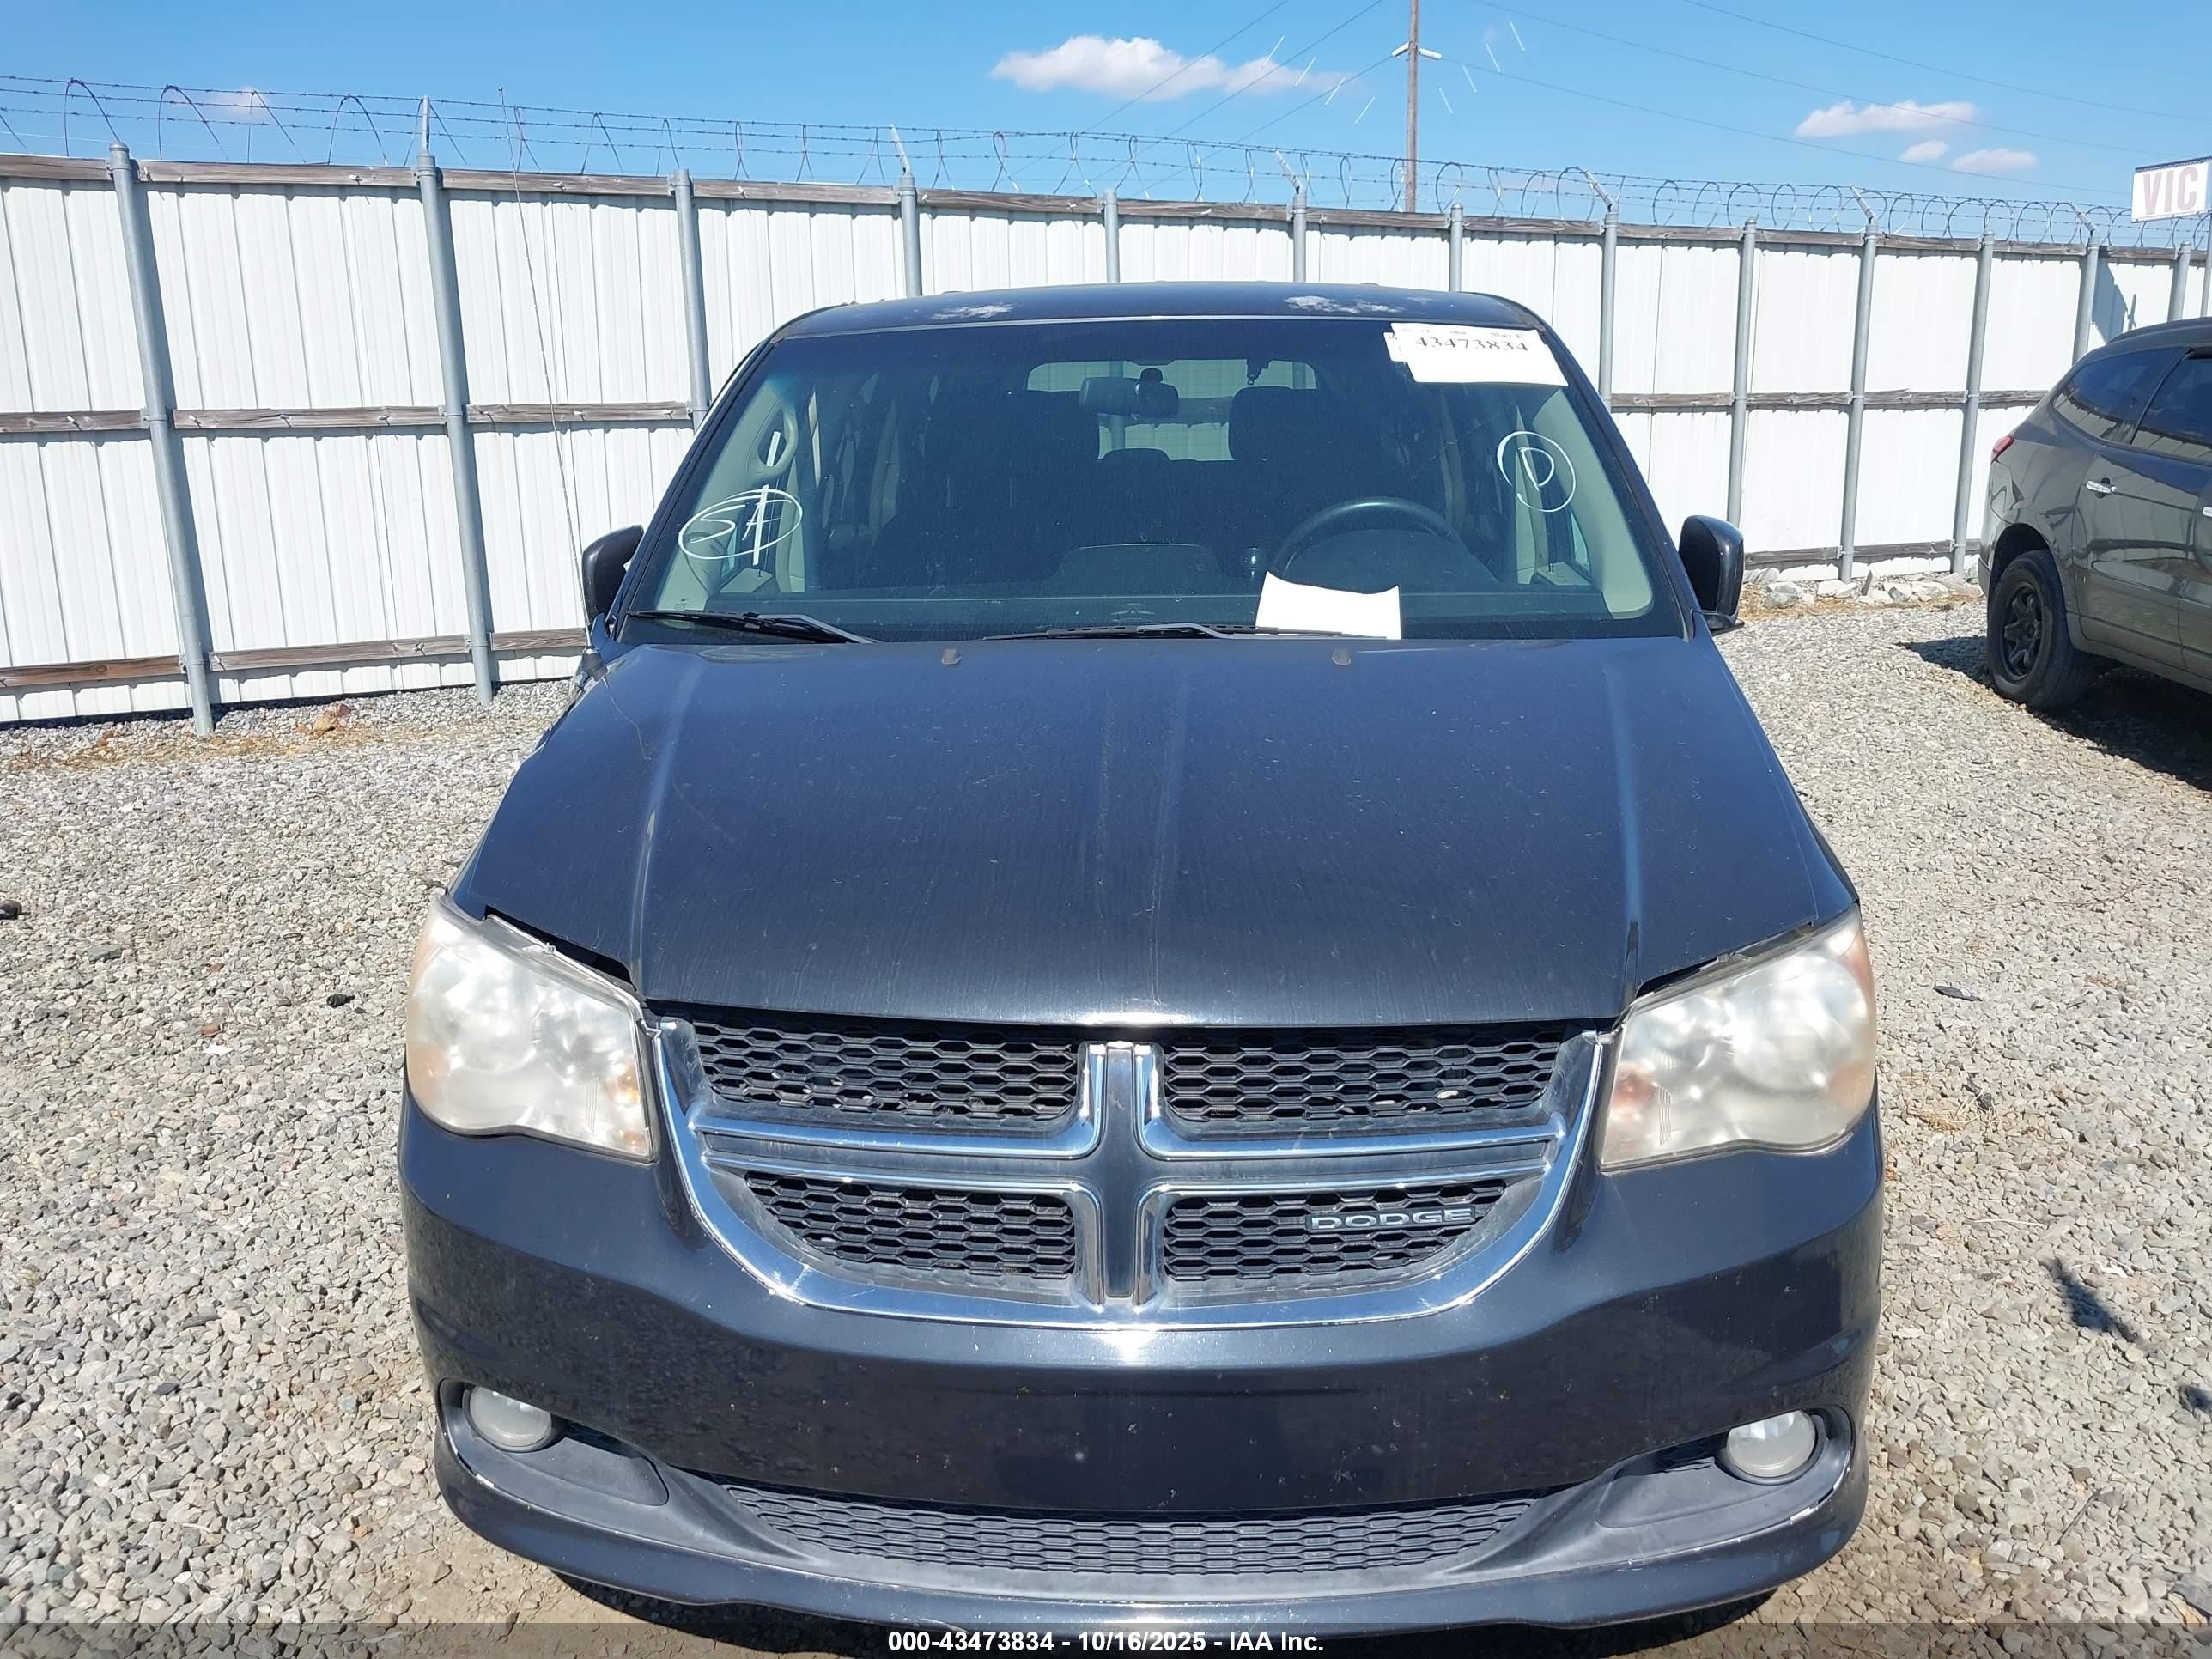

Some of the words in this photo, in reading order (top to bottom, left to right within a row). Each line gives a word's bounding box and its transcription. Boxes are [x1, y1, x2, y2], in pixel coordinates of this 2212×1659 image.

[2142, 167, 2198, 215] VIC
[1415, 337, 1529, 352] 43473834
[1311, 1207, 1473, 1230] DODGE
